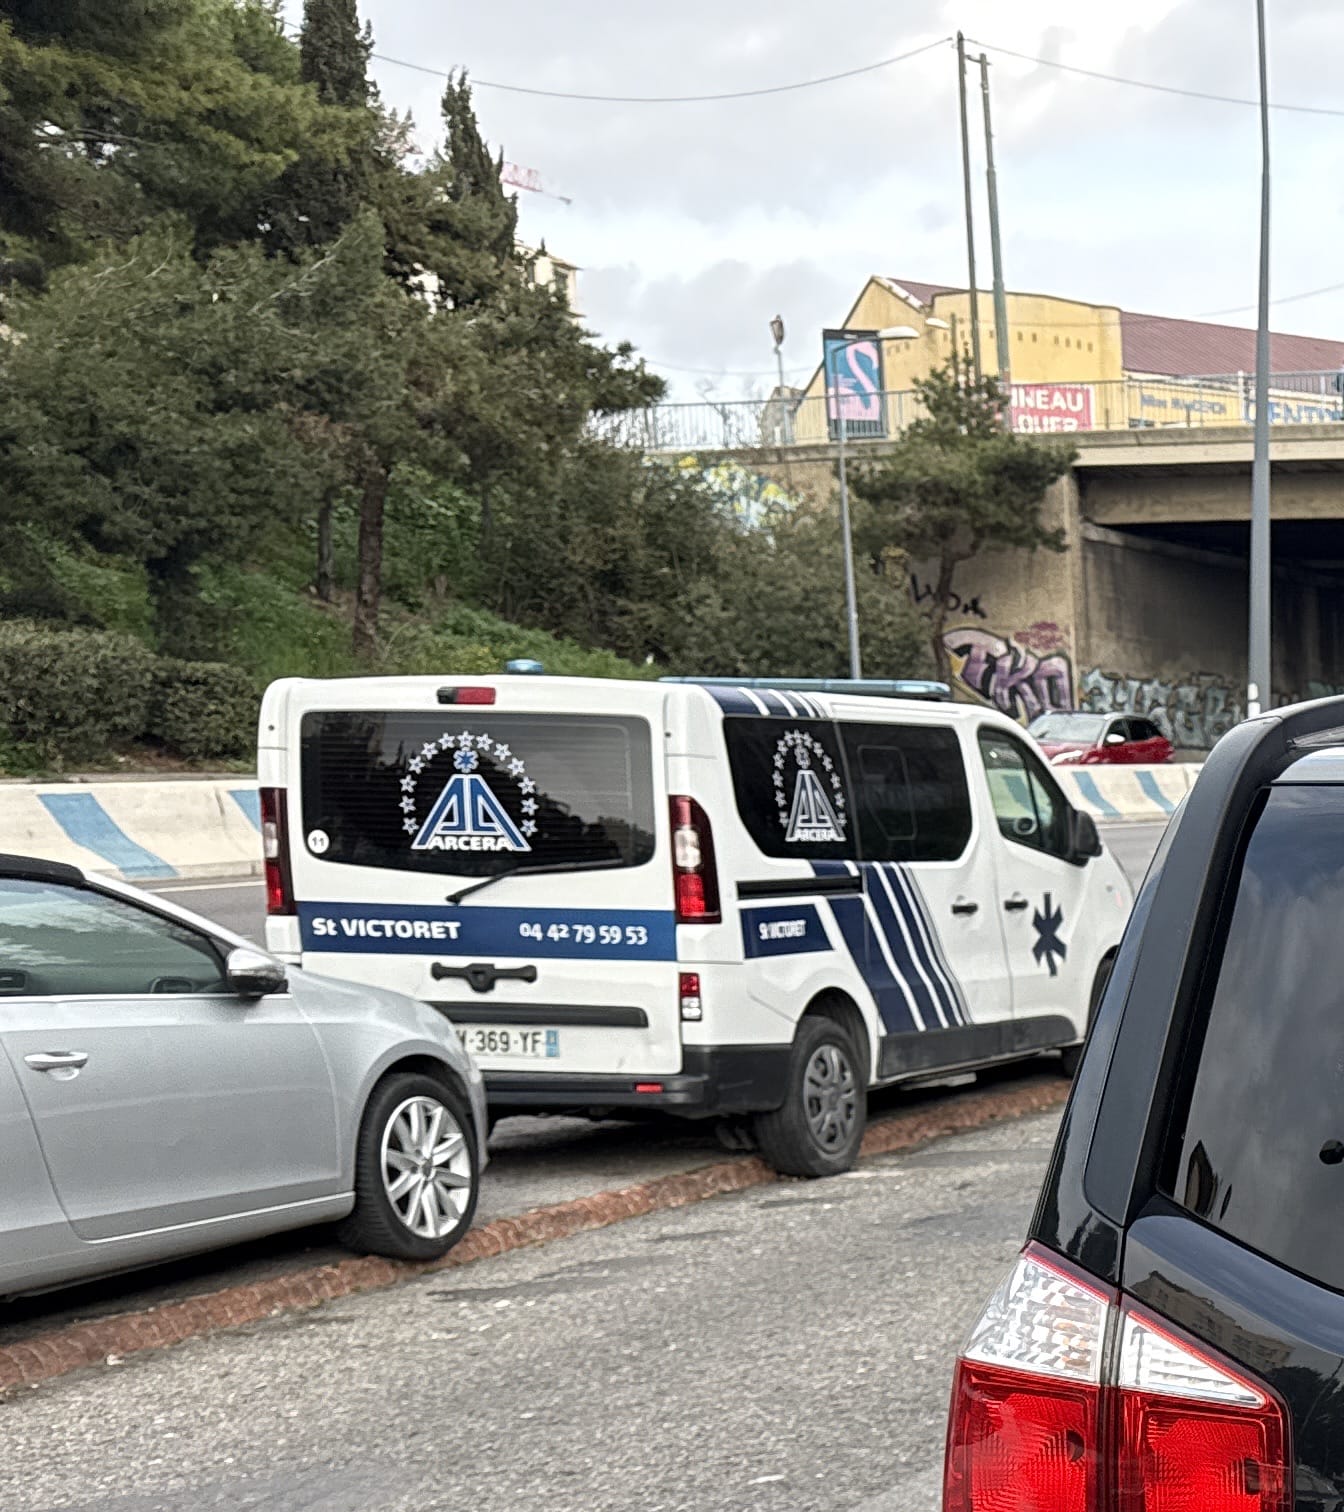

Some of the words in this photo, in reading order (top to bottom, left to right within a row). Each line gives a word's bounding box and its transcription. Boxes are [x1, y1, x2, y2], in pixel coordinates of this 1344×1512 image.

[1012, 414, 1078, 433] OUER
[428, 835, 514, 851] ARCERA
[312, 917, 337, 936] St
[341, 918, 462, 940] VICTORET
[519, 922, 543, 942] 04
[546, 923, 570, 942] 42
[572, 924, 596, 944] 79
[599, 925, 622, 945] 59
[625, 925, 648, 946] 53
